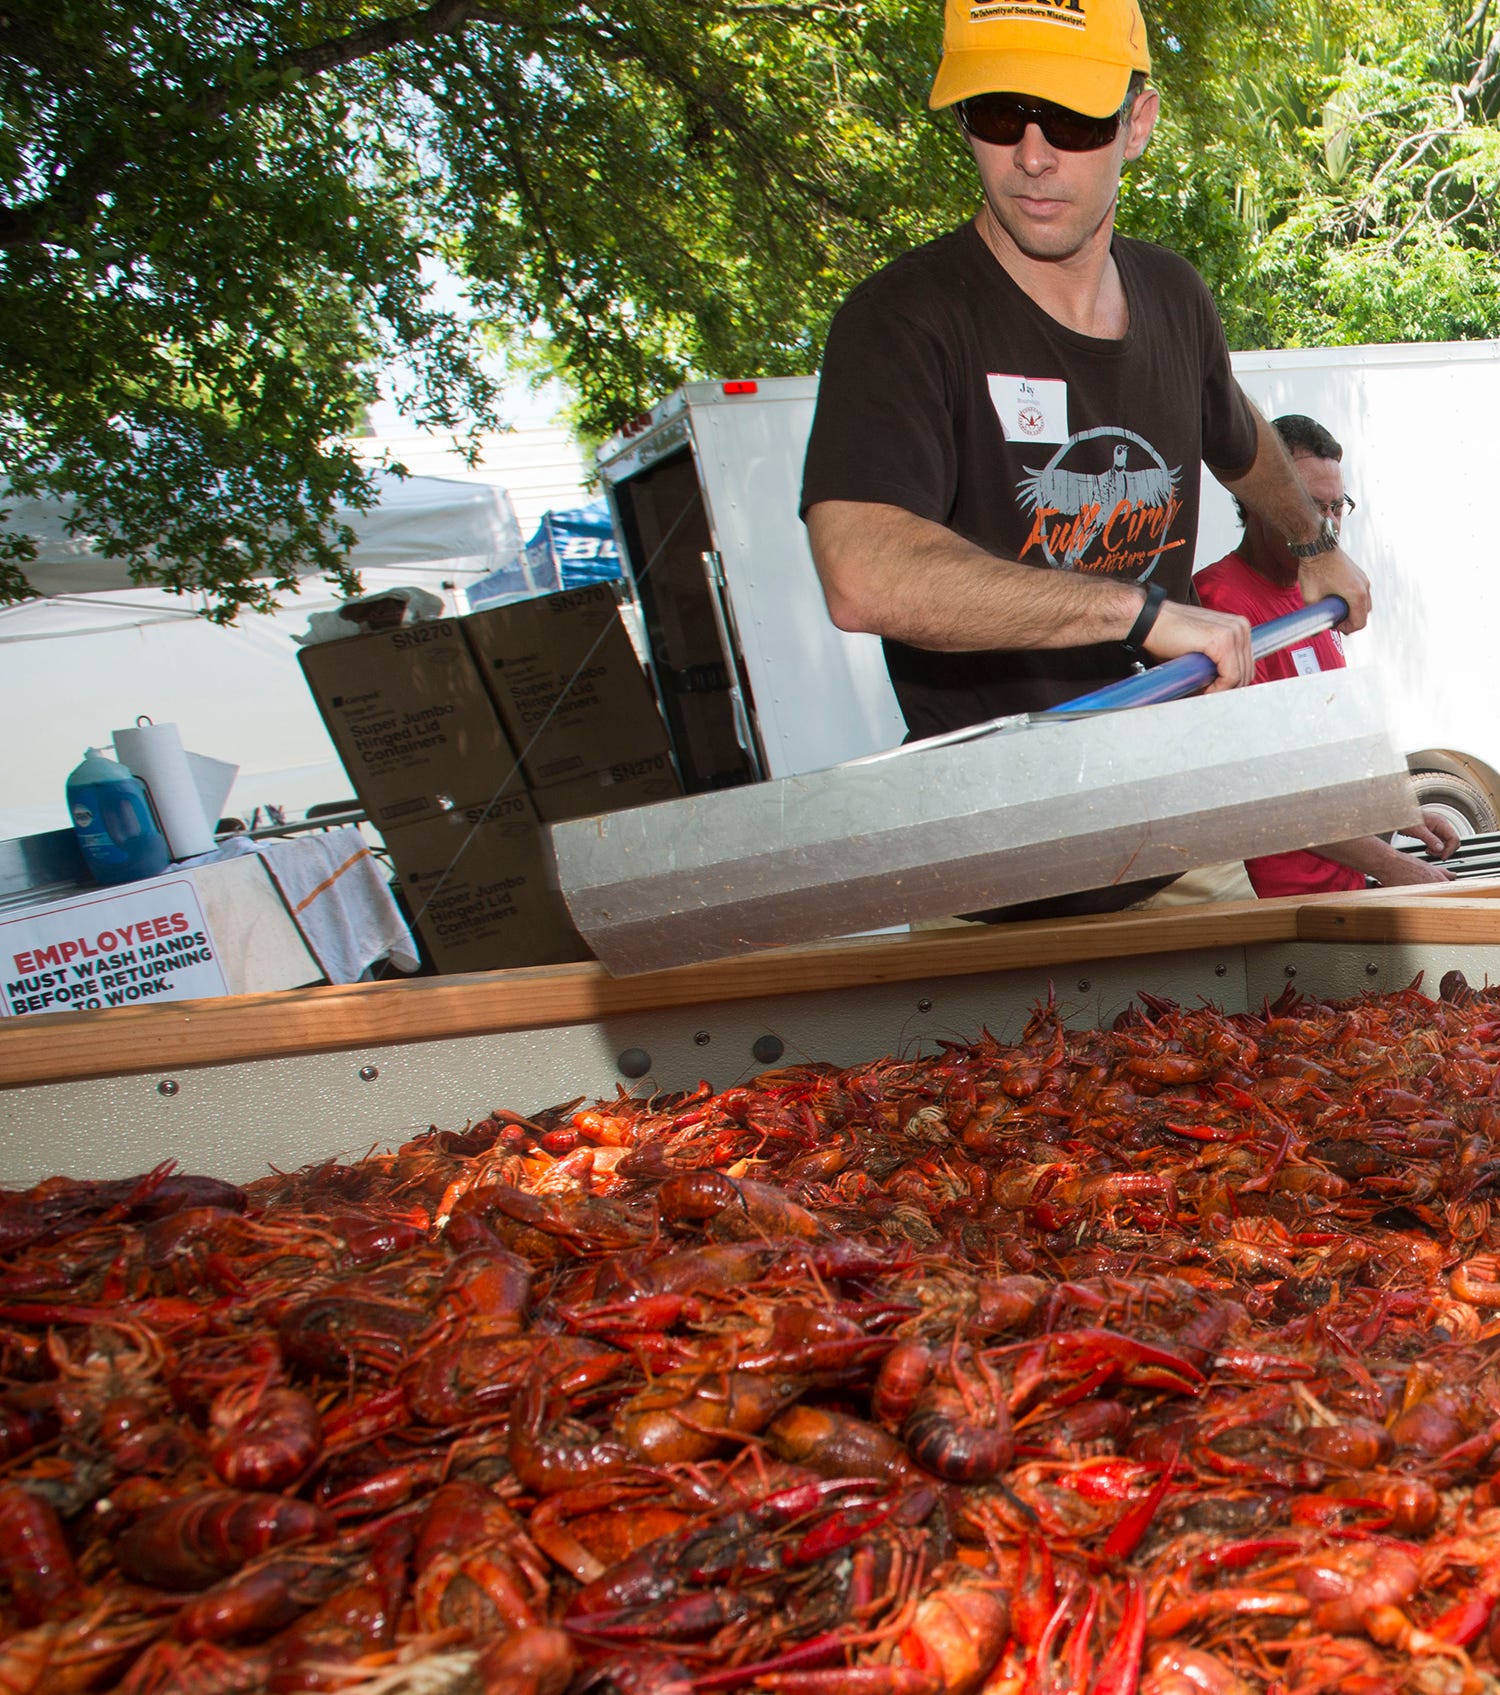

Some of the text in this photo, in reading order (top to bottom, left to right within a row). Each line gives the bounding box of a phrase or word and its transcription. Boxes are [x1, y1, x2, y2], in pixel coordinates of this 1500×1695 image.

[1015, 6, 1046, 17] Southern
[549, 587, 606, 613] SN270
[391, 623, 453, 649] SN270
[349, 718, 398, 738] Super
[401, 704, 455, 725] Jumbo
[355, 720, 441, 751] Hinged Lid
[361, 734, 448, 763] Containers
[610, 754, 666, 784] SN270
[428, 892, 471, 912] Super
[475, 876, 526, 898] Jumbo
[430, 893, 512, 924] Hinged Lid
[436, 906, 519, 935] Containers
[13, 912, 189, 976] EMPLOYEES
[7, 931, 208, 998] MUST WASH HANDS
[11, 947, 214, 1015] BEFORE RETURNING
[71, 977, 175, 1010] TO WORK.
